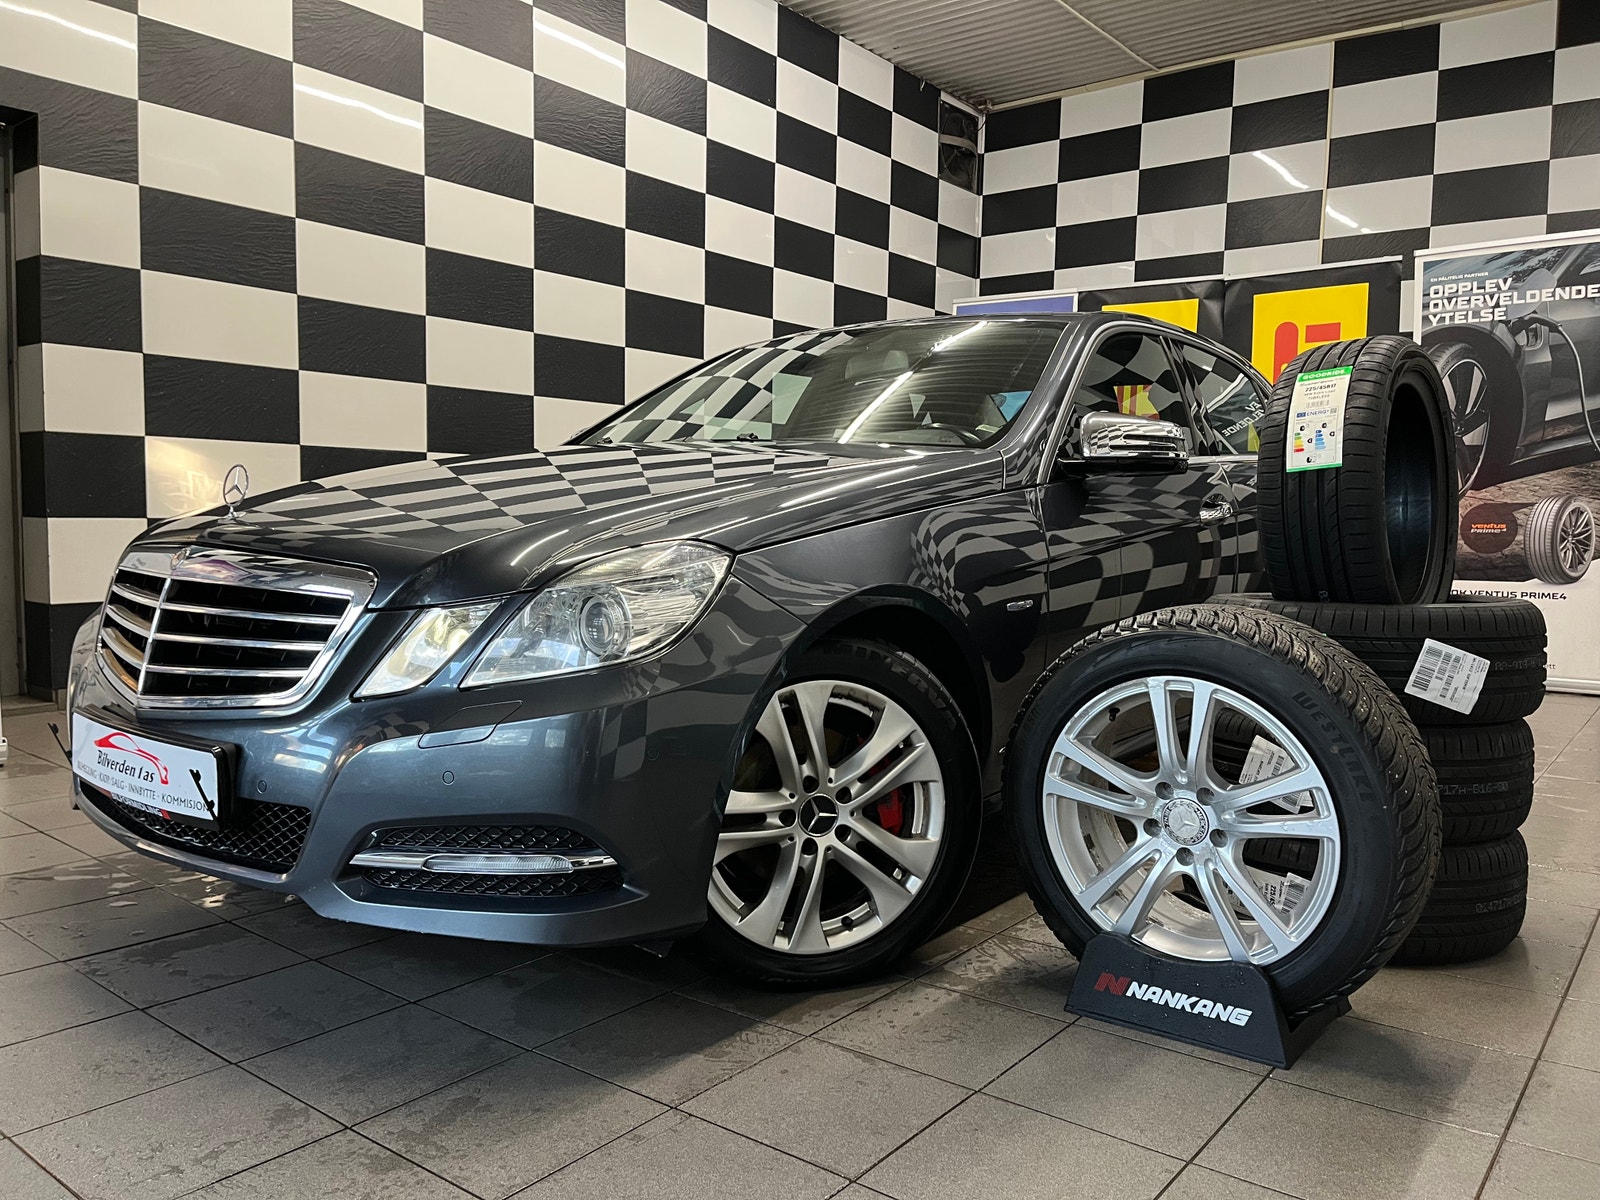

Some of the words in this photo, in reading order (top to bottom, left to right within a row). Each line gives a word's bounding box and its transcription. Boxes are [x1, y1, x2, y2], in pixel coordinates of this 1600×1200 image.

[1430, 278, 1513, 298] OPPLEV
[1429, 284, 1600, 313] OVERVELDENDE
[1428, 307, 1507, 327] YTELSE
[1303, 370, 1345, 380] GOODRIDE
[1520, 591, 1567, 600] PRIME4
[1292, 691, 1374, 800] WESTLAKE
[97, 749, 136, 778] Bilverden
[143, 770, 156, 783] as
[128, 782, 156, 800] INNBYTTE
[1126, 981, 1253, 1027] NANKANG
